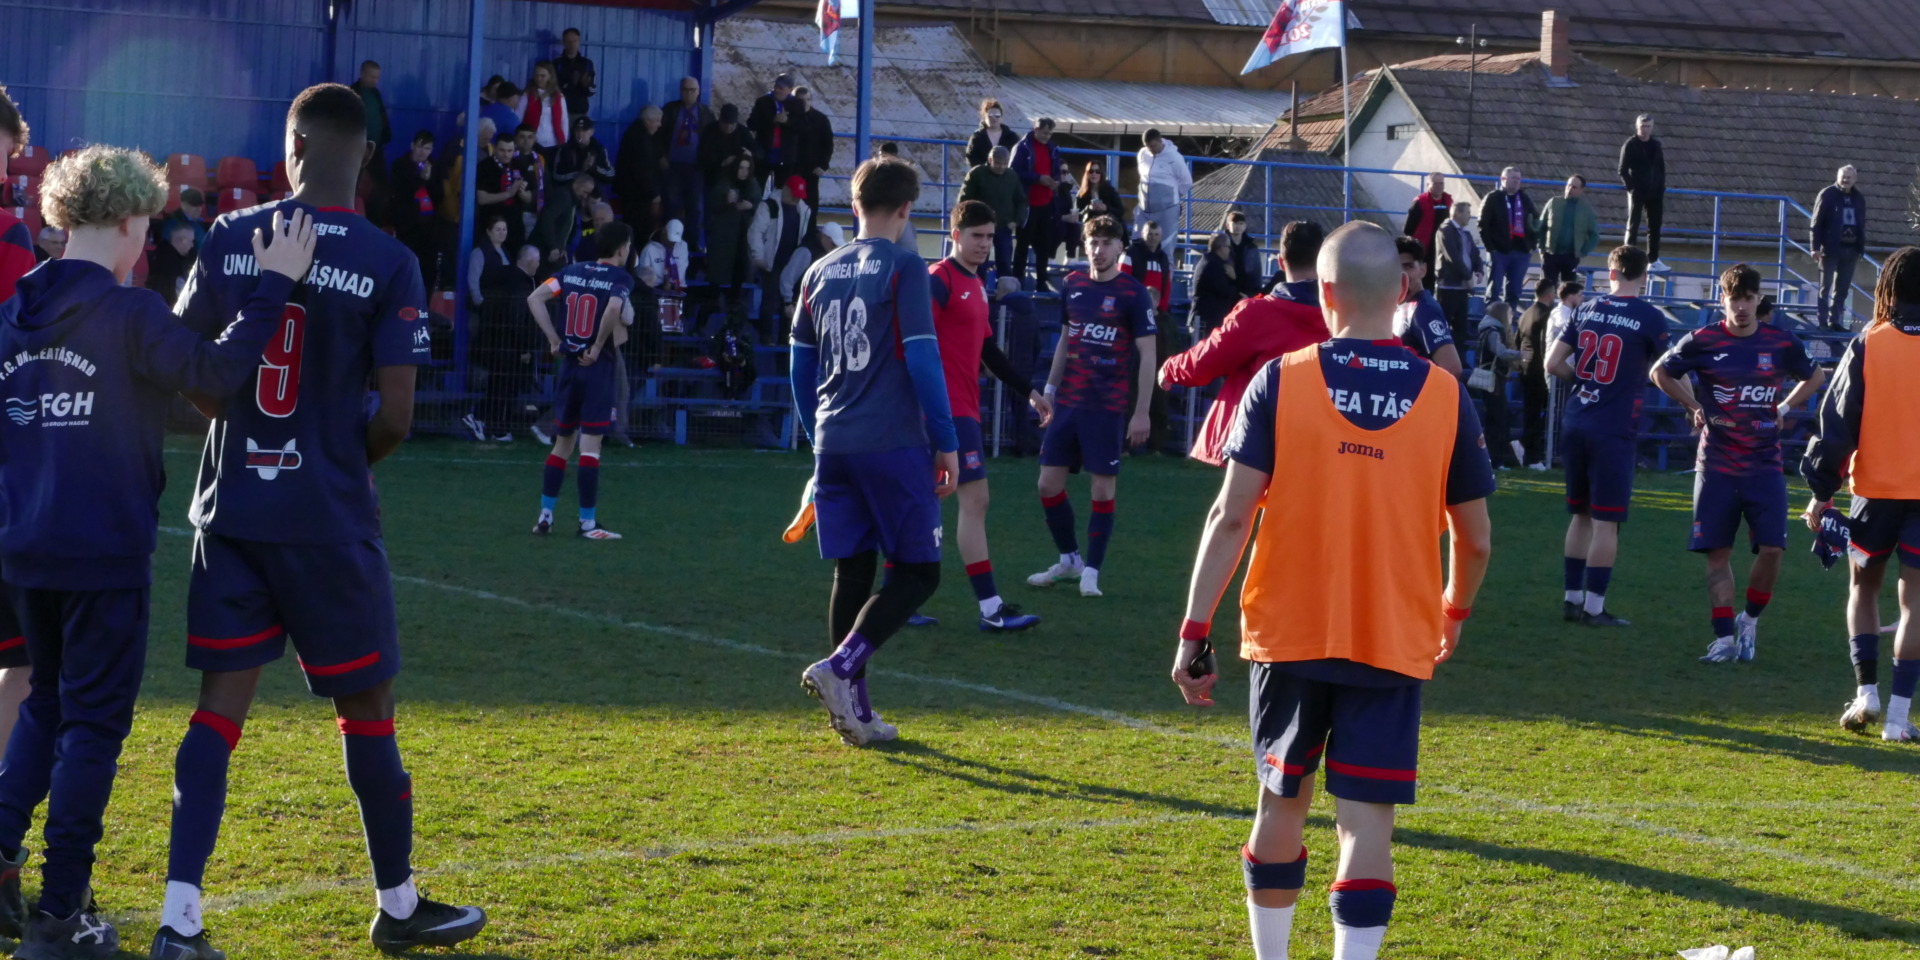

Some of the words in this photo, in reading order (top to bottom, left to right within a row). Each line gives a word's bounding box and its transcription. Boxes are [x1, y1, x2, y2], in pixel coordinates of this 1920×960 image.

[223, 253, 262, 277] UNI
[304, 259, 375, 298] ĂȘNAD
[822, 262, 852, 280] UNIREA
[565, 291, 598, 339] 10
[821, 296, 871, 374] 18
[1082, 323, 1117, 341] FGH
[256, 302, 306, 418] 9
[1575, 329, 1623, 385] 29
[40, 391, 95, 418] FGH
[1740, 385, 1776, 402] FGH
